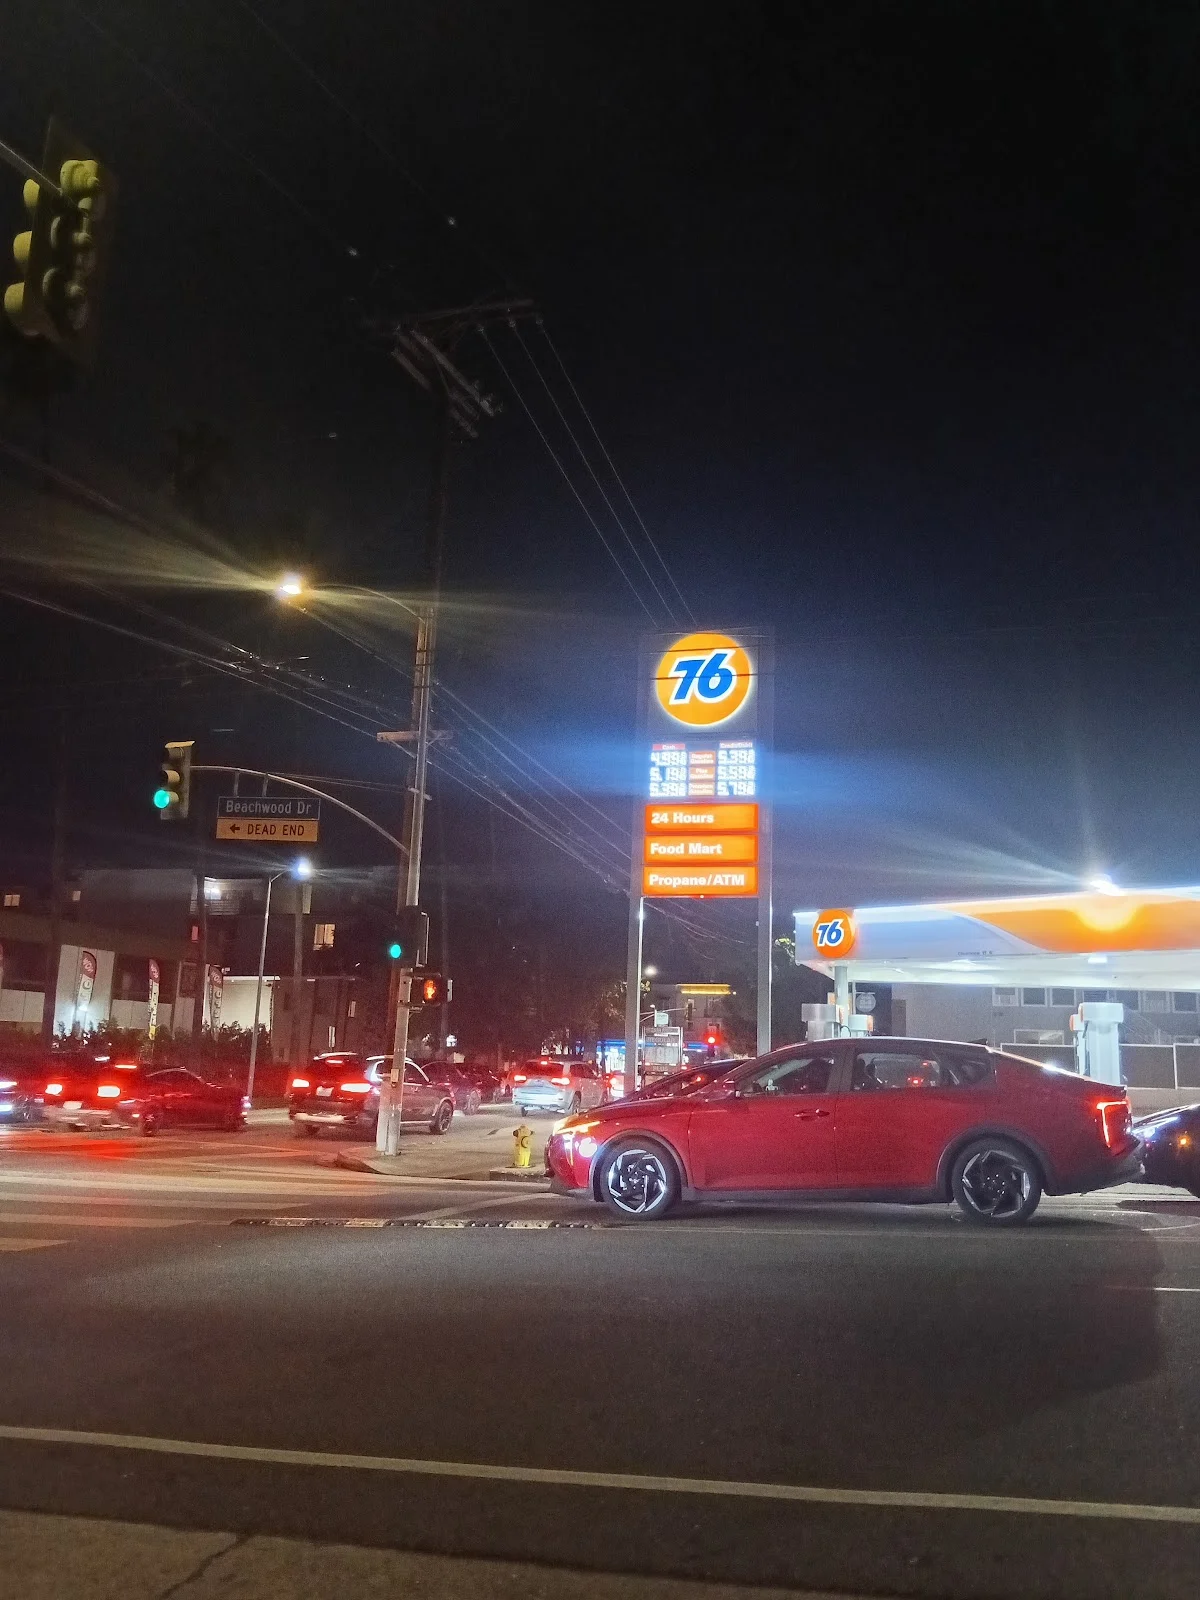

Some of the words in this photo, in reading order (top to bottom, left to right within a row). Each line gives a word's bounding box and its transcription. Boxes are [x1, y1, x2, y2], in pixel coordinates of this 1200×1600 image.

[668, 649, 737, 705] 76
[226, 800, 291, 814] Beachwood
[297, 802, 312, 815] Dr
[651, 812, 669, 824] 24
[673, 812, 714, 823] Hours
[247, 824, 276, 835] DEAD
[282, 825, 305, 836] END
[650, 842, 685, 854] Food
[688, 842, 723, 854] Mart
[649, 874, 745, 887] Propane/ATM
[816, 918, 845, 947] 76
